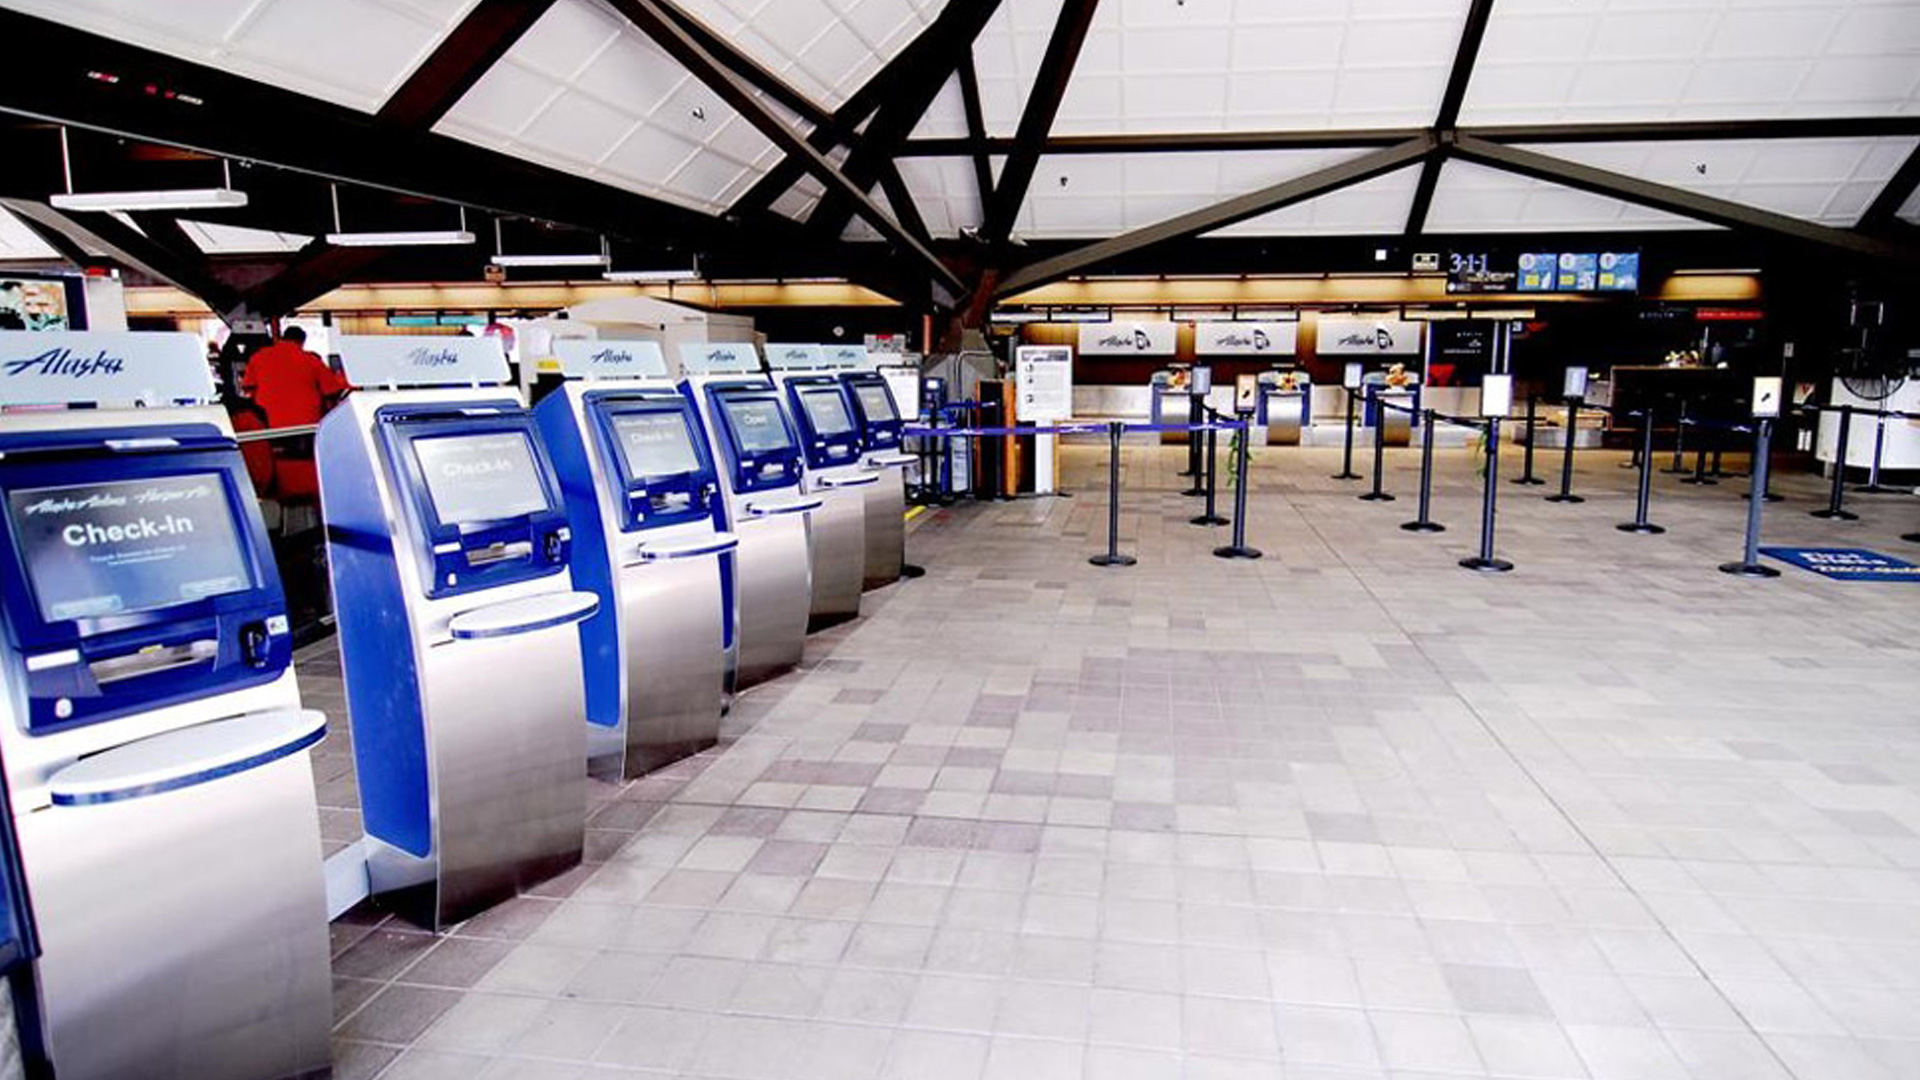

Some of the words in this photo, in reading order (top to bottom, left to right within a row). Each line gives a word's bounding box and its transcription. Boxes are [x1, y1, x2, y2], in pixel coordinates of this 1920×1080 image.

[1449, 253, 1487, 273] 3-1-1
[3, 348, 124, 378] Alaska
[407, 347, 458, 367] Alaska
[590, 348, 633, 364] Alaska
[62, 514, 194, 547] Check-In
